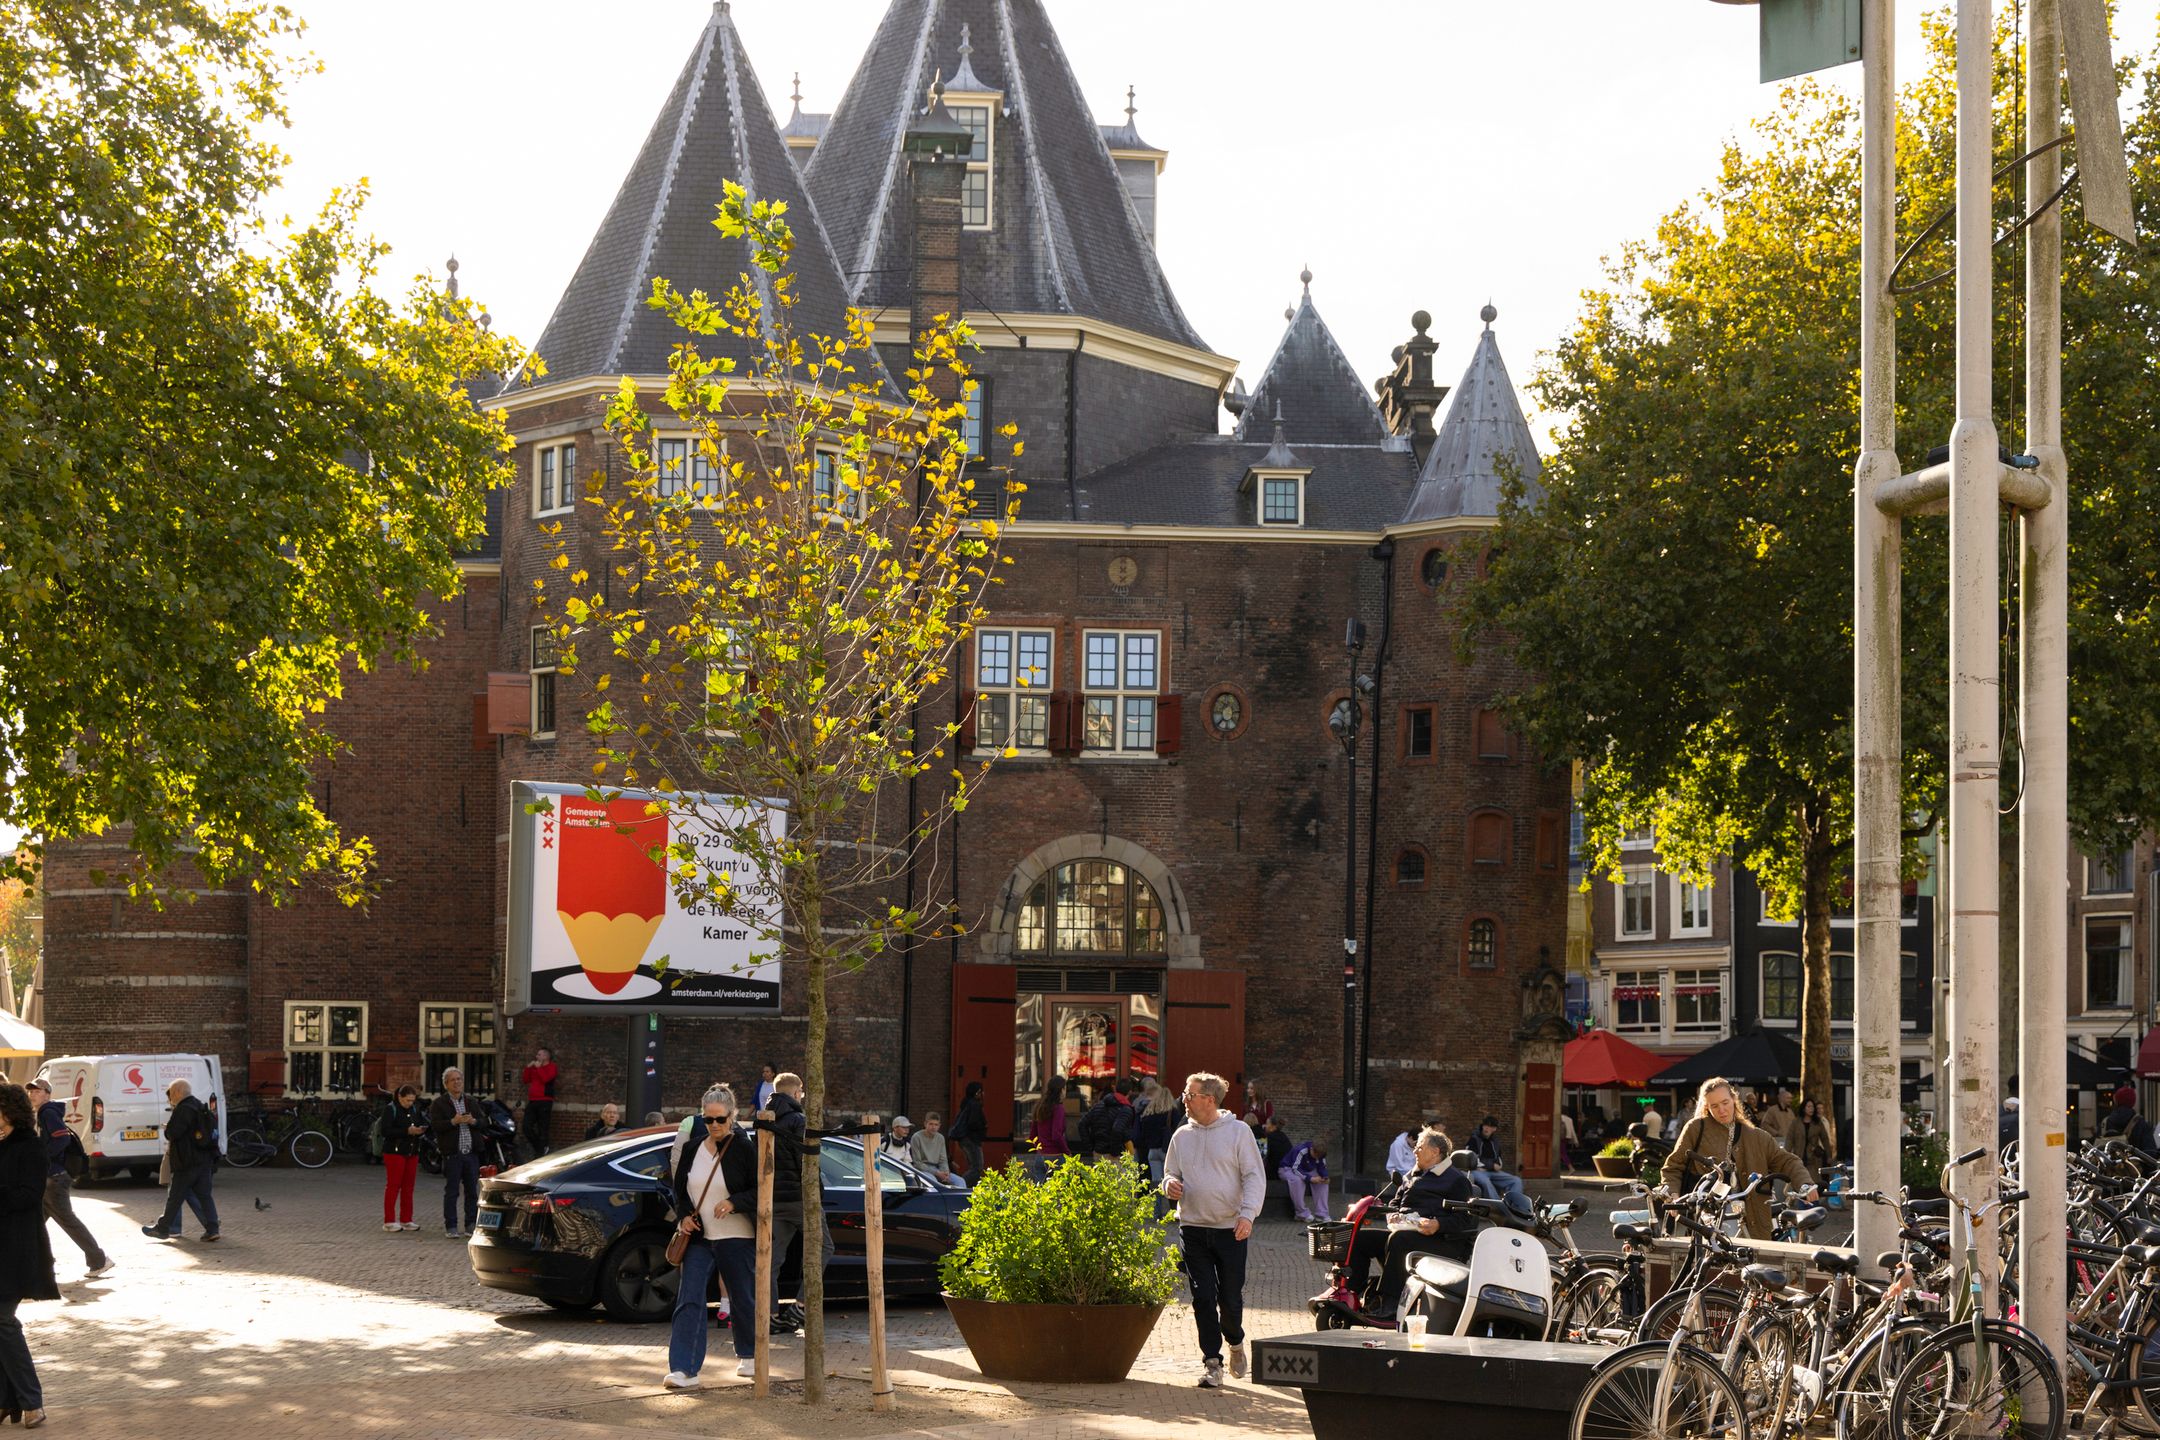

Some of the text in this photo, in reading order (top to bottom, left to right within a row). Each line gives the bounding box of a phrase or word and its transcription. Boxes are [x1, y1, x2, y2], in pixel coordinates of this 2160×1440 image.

[565, 807, 607, 817] Gemeente
[703, 834, 720, 848] 29
[707, 856, 749, 873] kunt u
[745, 882, 776, 897] voor
[687, 902, 705, 916] de
[703, 926, 748, 940] Kamer
[671, 988, 769, 1000] amsterdam.nl/verkiezingen
